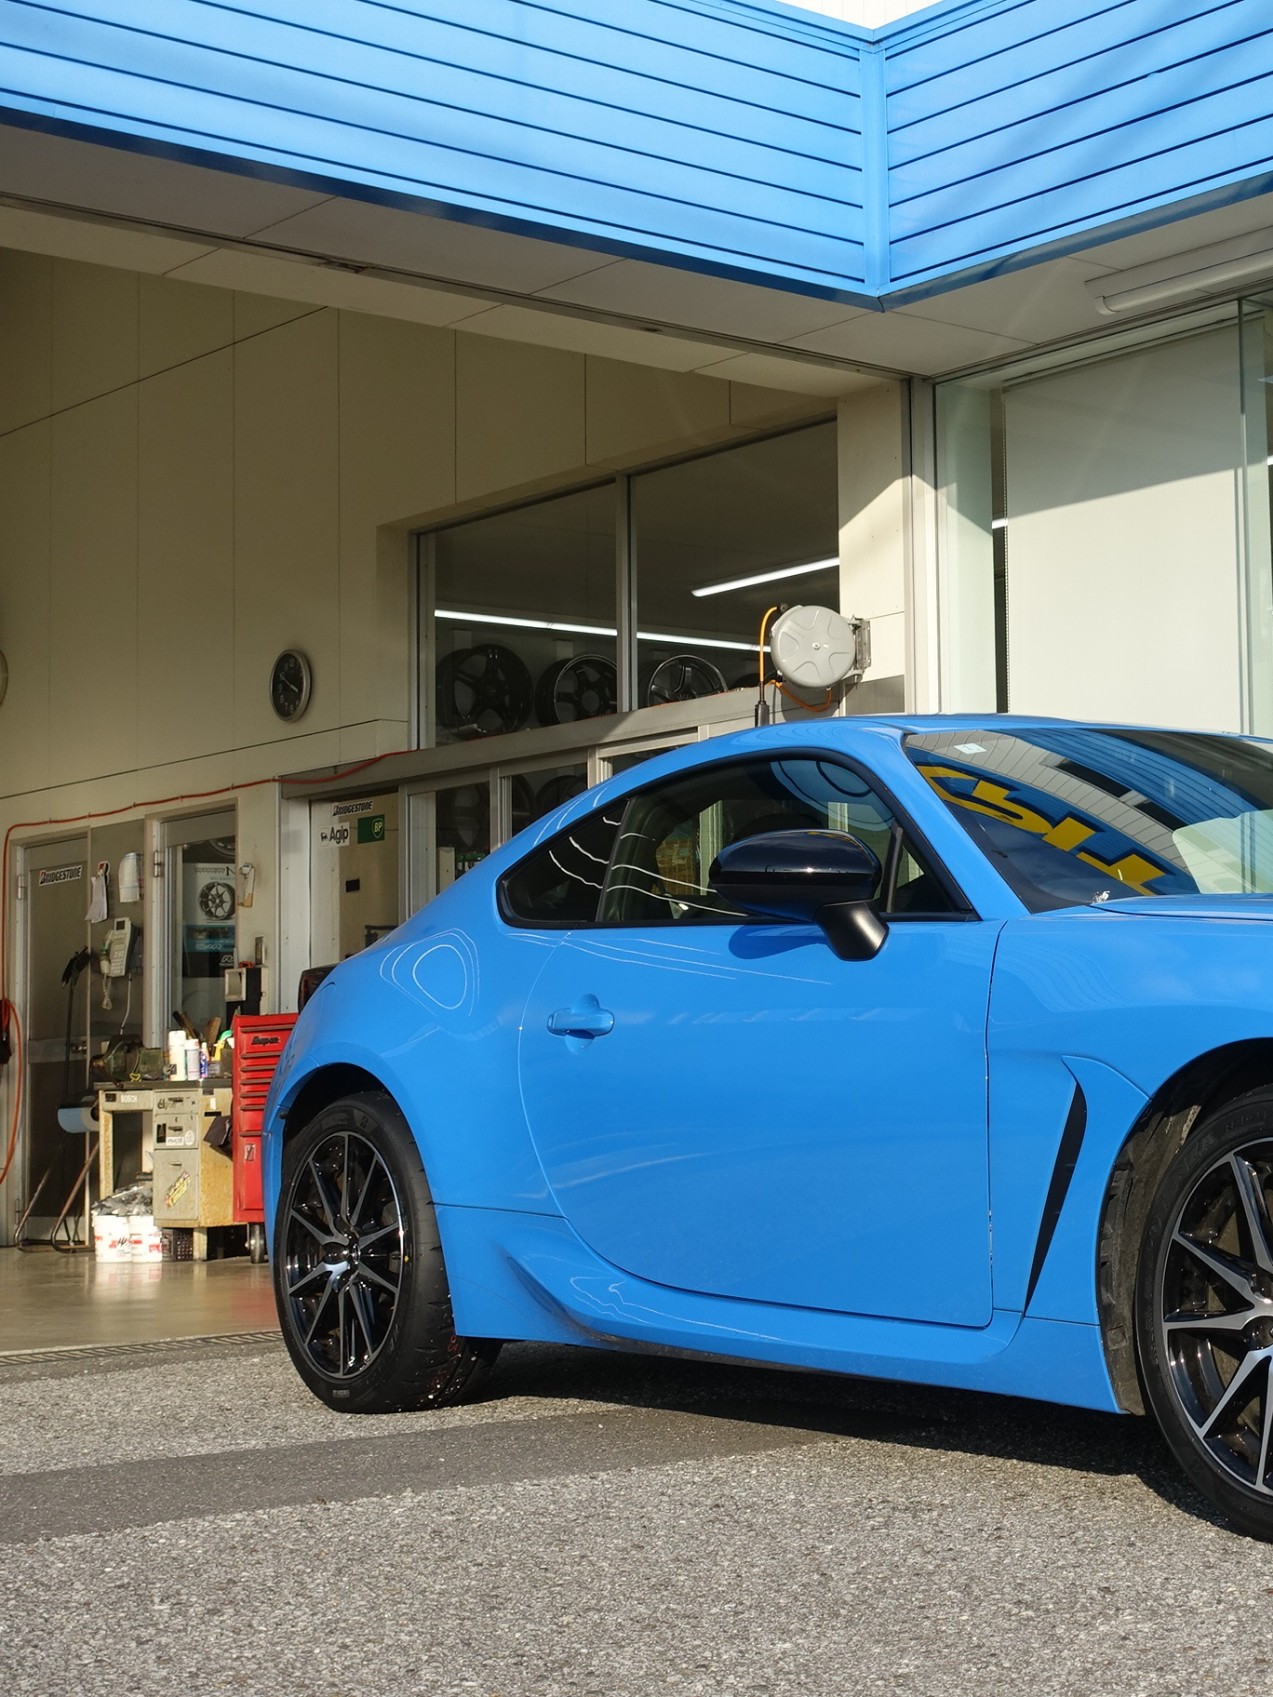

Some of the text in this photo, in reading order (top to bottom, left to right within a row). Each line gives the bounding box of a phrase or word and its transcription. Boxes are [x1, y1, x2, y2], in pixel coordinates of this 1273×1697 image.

[332, 801, 373, 816] BRIDGESTONE
[329, 825, 349, 845] Agip
[374, 821, 383, 833] BP
[40, 866, 82, 885] BRIDGESTONE
